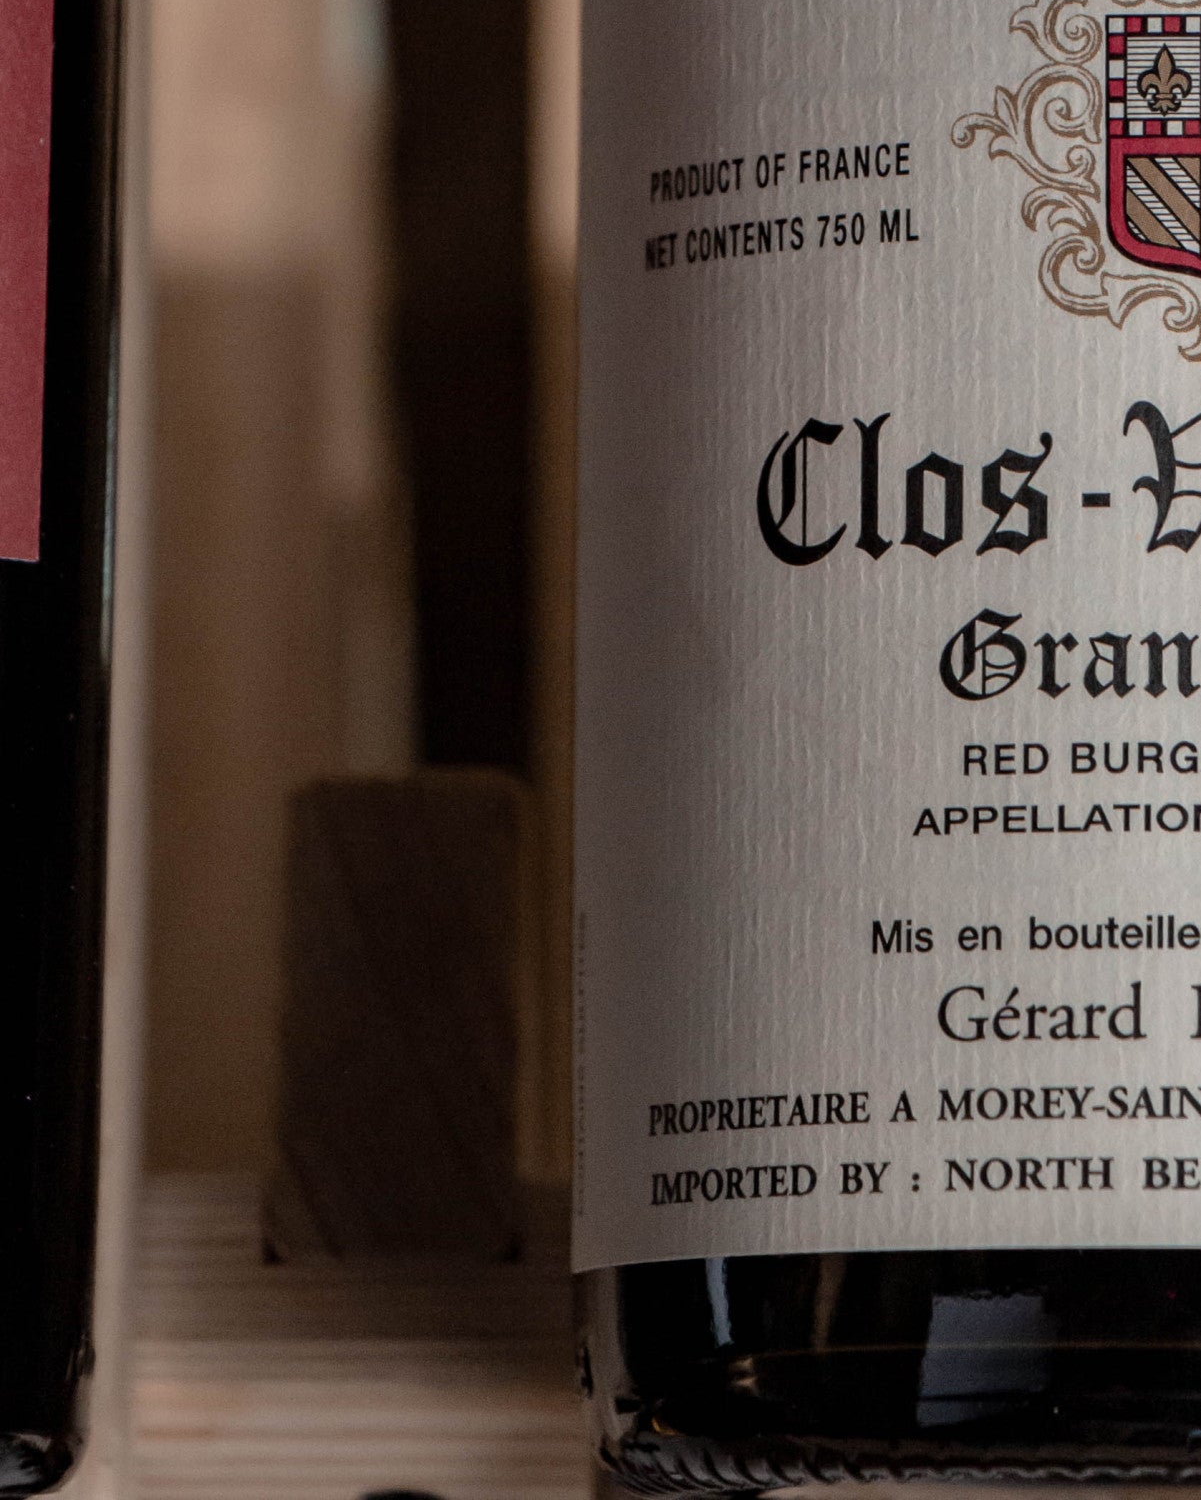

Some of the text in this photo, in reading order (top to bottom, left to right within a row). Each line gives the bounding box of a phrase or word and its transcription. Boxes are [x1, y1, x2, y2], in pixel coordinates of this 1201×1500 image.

[650, 142, 911, 202] PRODUCT OF FRANCE
[644, 208, 920, 272] NET CONTENTS 750 ML
[963, 742, 1050, 777] RED
[871, 919, 934, 955] Mis
[957, 924, 1003, 953] en
[1029, 914, 1201, 951] bouteille
[937, 980, 1147, 1043] Gérard
[650, 1091, 871, 1136] PROPRIETAIRE
[889, 1089, 917, 1123] A
[651, 1163, 818, 1206] IMPORTED
[840, 1161, 891, 1196] BY
[944, 1157, 1114, 1192] NORTH
